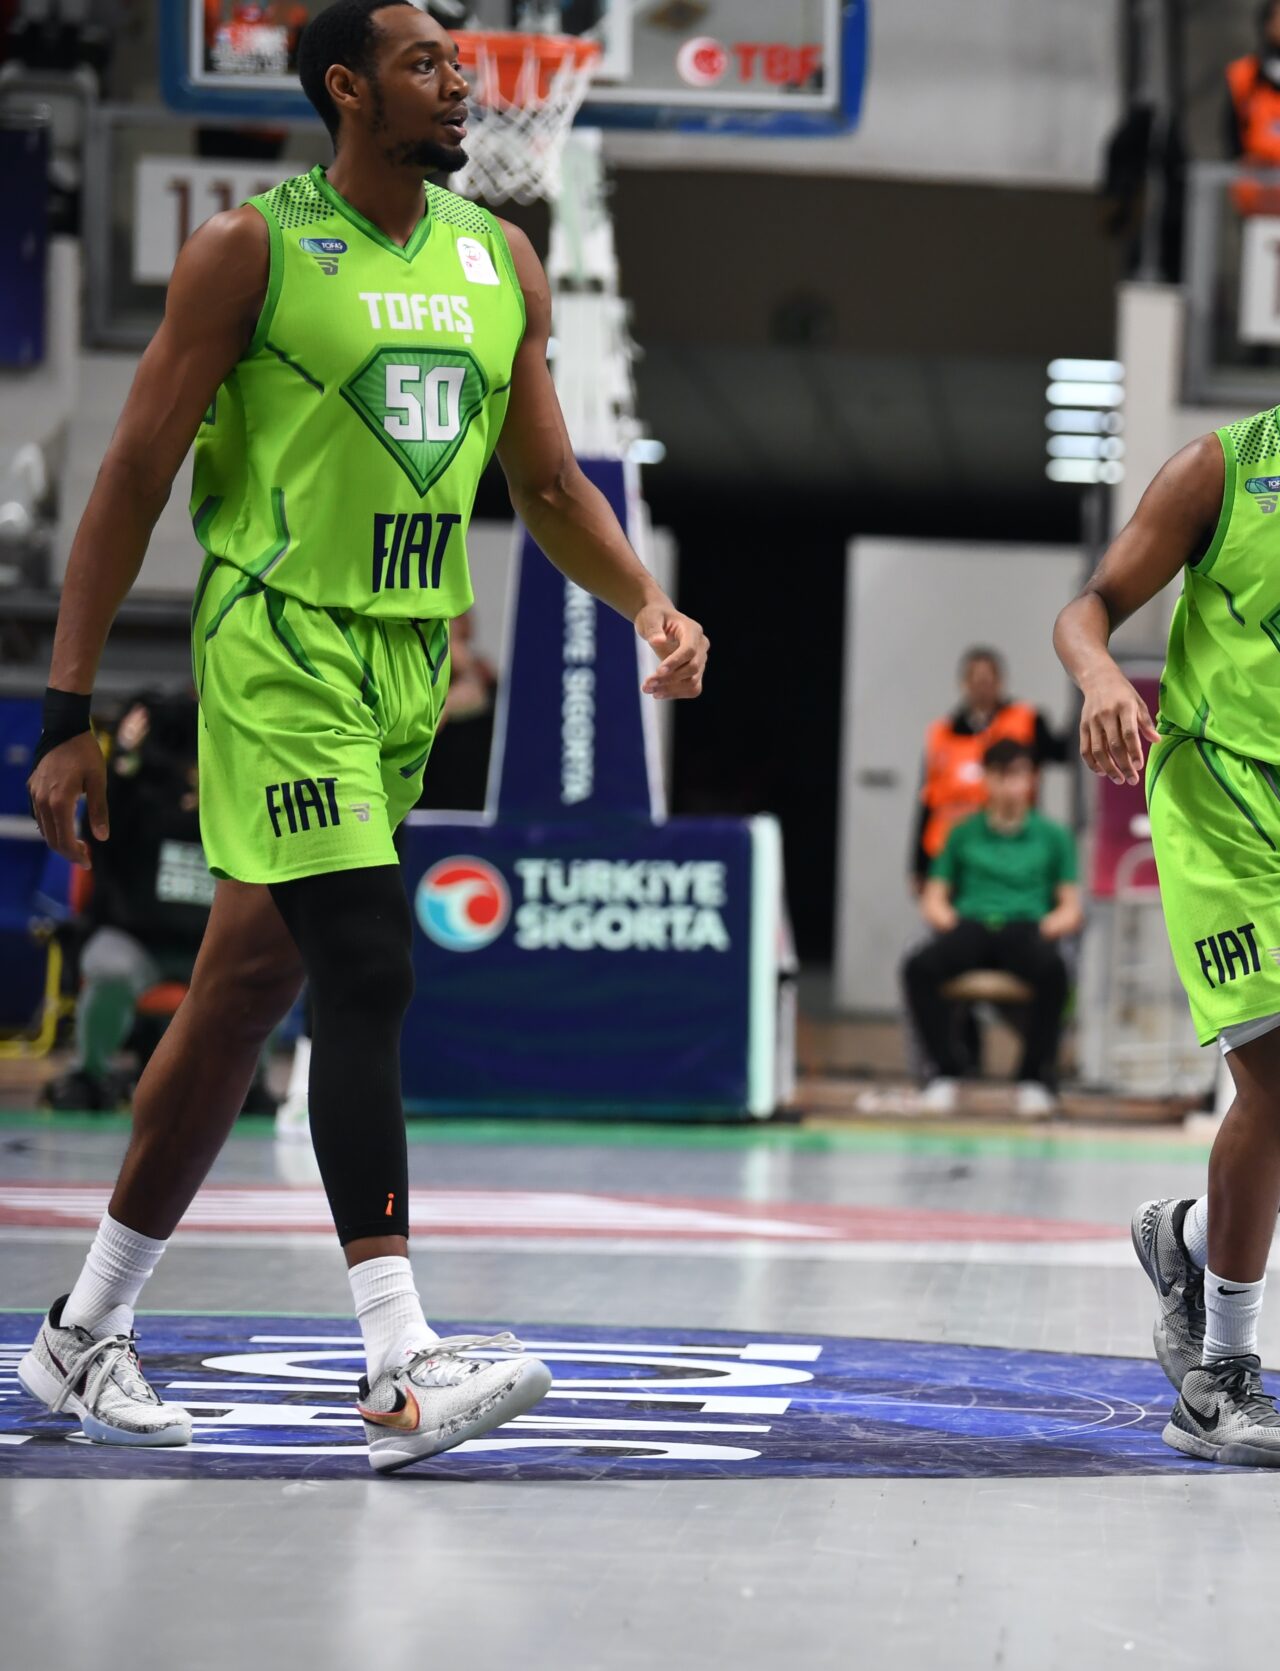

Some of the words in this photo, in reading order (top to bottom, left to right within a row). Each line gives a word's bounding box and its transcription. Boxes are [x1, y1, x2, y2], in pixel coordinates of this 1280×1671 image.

[358, 292, 474, 344] TOFAŞ
[384, 364, 466, 441] 50
[372, 513, 462, 593] FIAT
[265, 777, 341, 838] FIAT
[1194, 922, 1262, 989] FIAT
